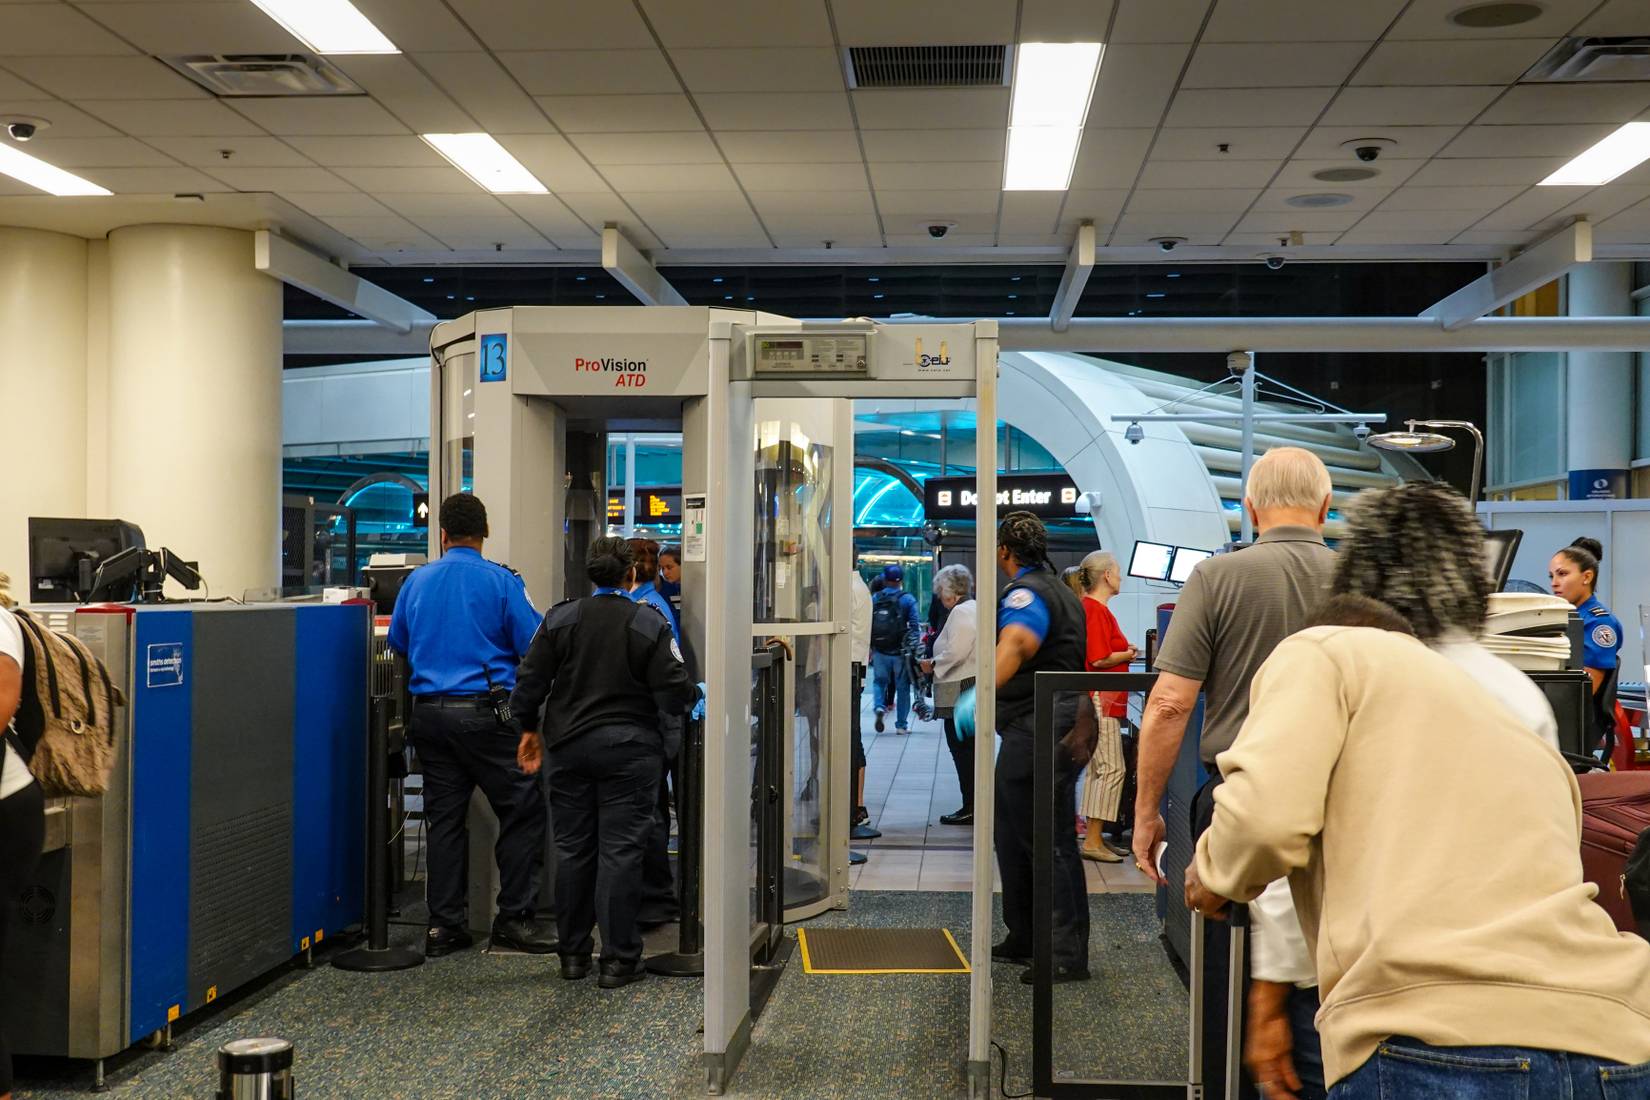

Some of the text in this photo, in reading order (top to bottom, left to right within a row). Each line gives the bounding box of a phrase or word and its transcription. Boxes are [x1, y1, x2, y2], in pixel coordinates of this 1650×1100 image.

[482, 343, 505, 376] 13
[575, 358, 647, 372] ProVision
[615, 373, 646, 387] ATD
[996, 490, 1010, 505] ot
[1012, 489, 1052, 505] Enter
